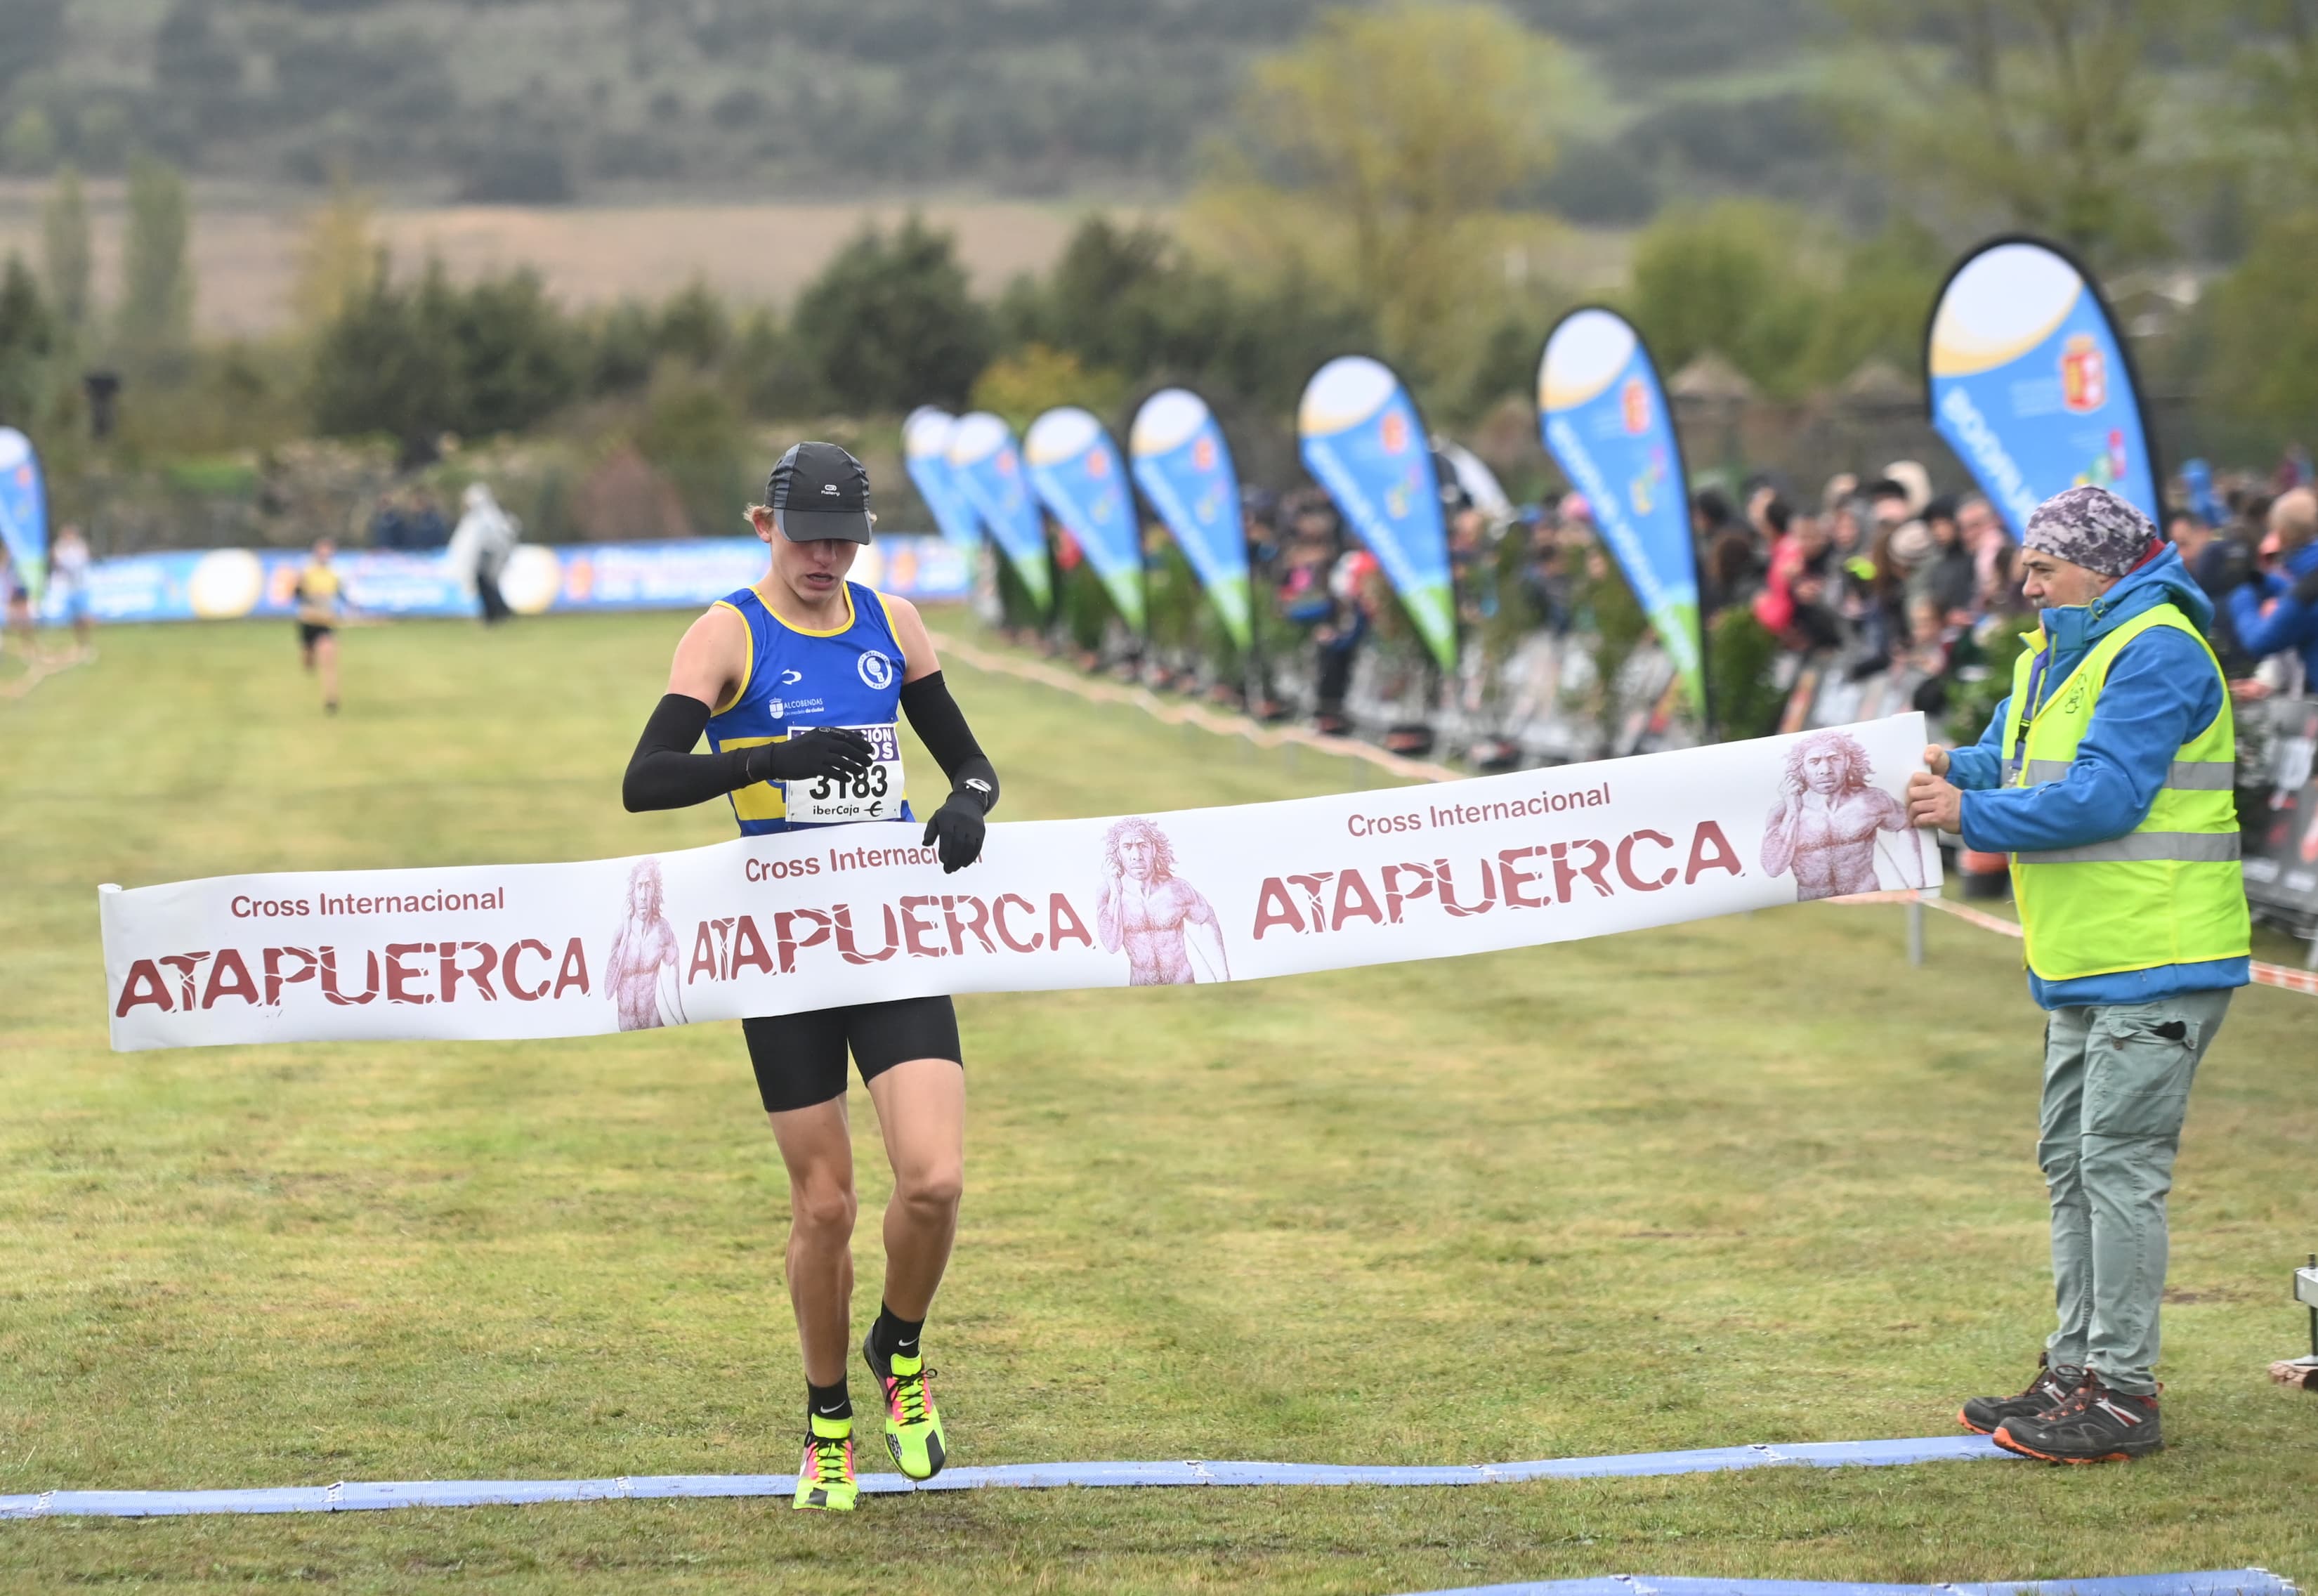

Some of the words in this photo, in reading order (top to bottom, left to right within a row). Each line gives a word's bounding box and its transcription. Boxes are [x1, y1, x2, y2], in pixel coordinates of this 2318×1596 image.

[784, 698, 823, 709] ALCOBENDAS
[813, 804, 860, 816] iberCaja
[1347, 813, 1421, 838] Cross
[1430, 782, 1611, 828] Internacional
[745, 856, 820, 882] Cross
[830, 846, 982, 872] Internaci
[1252, 820, 1746, 941] ATAPUERCA
[231, 895, 310, 917] Cross
[320, 887, 504, 915] Internacional
[688, 893, 1096, 986] ATAPUERCA
[116, 937, 591, 1017] ATAPUERCA
